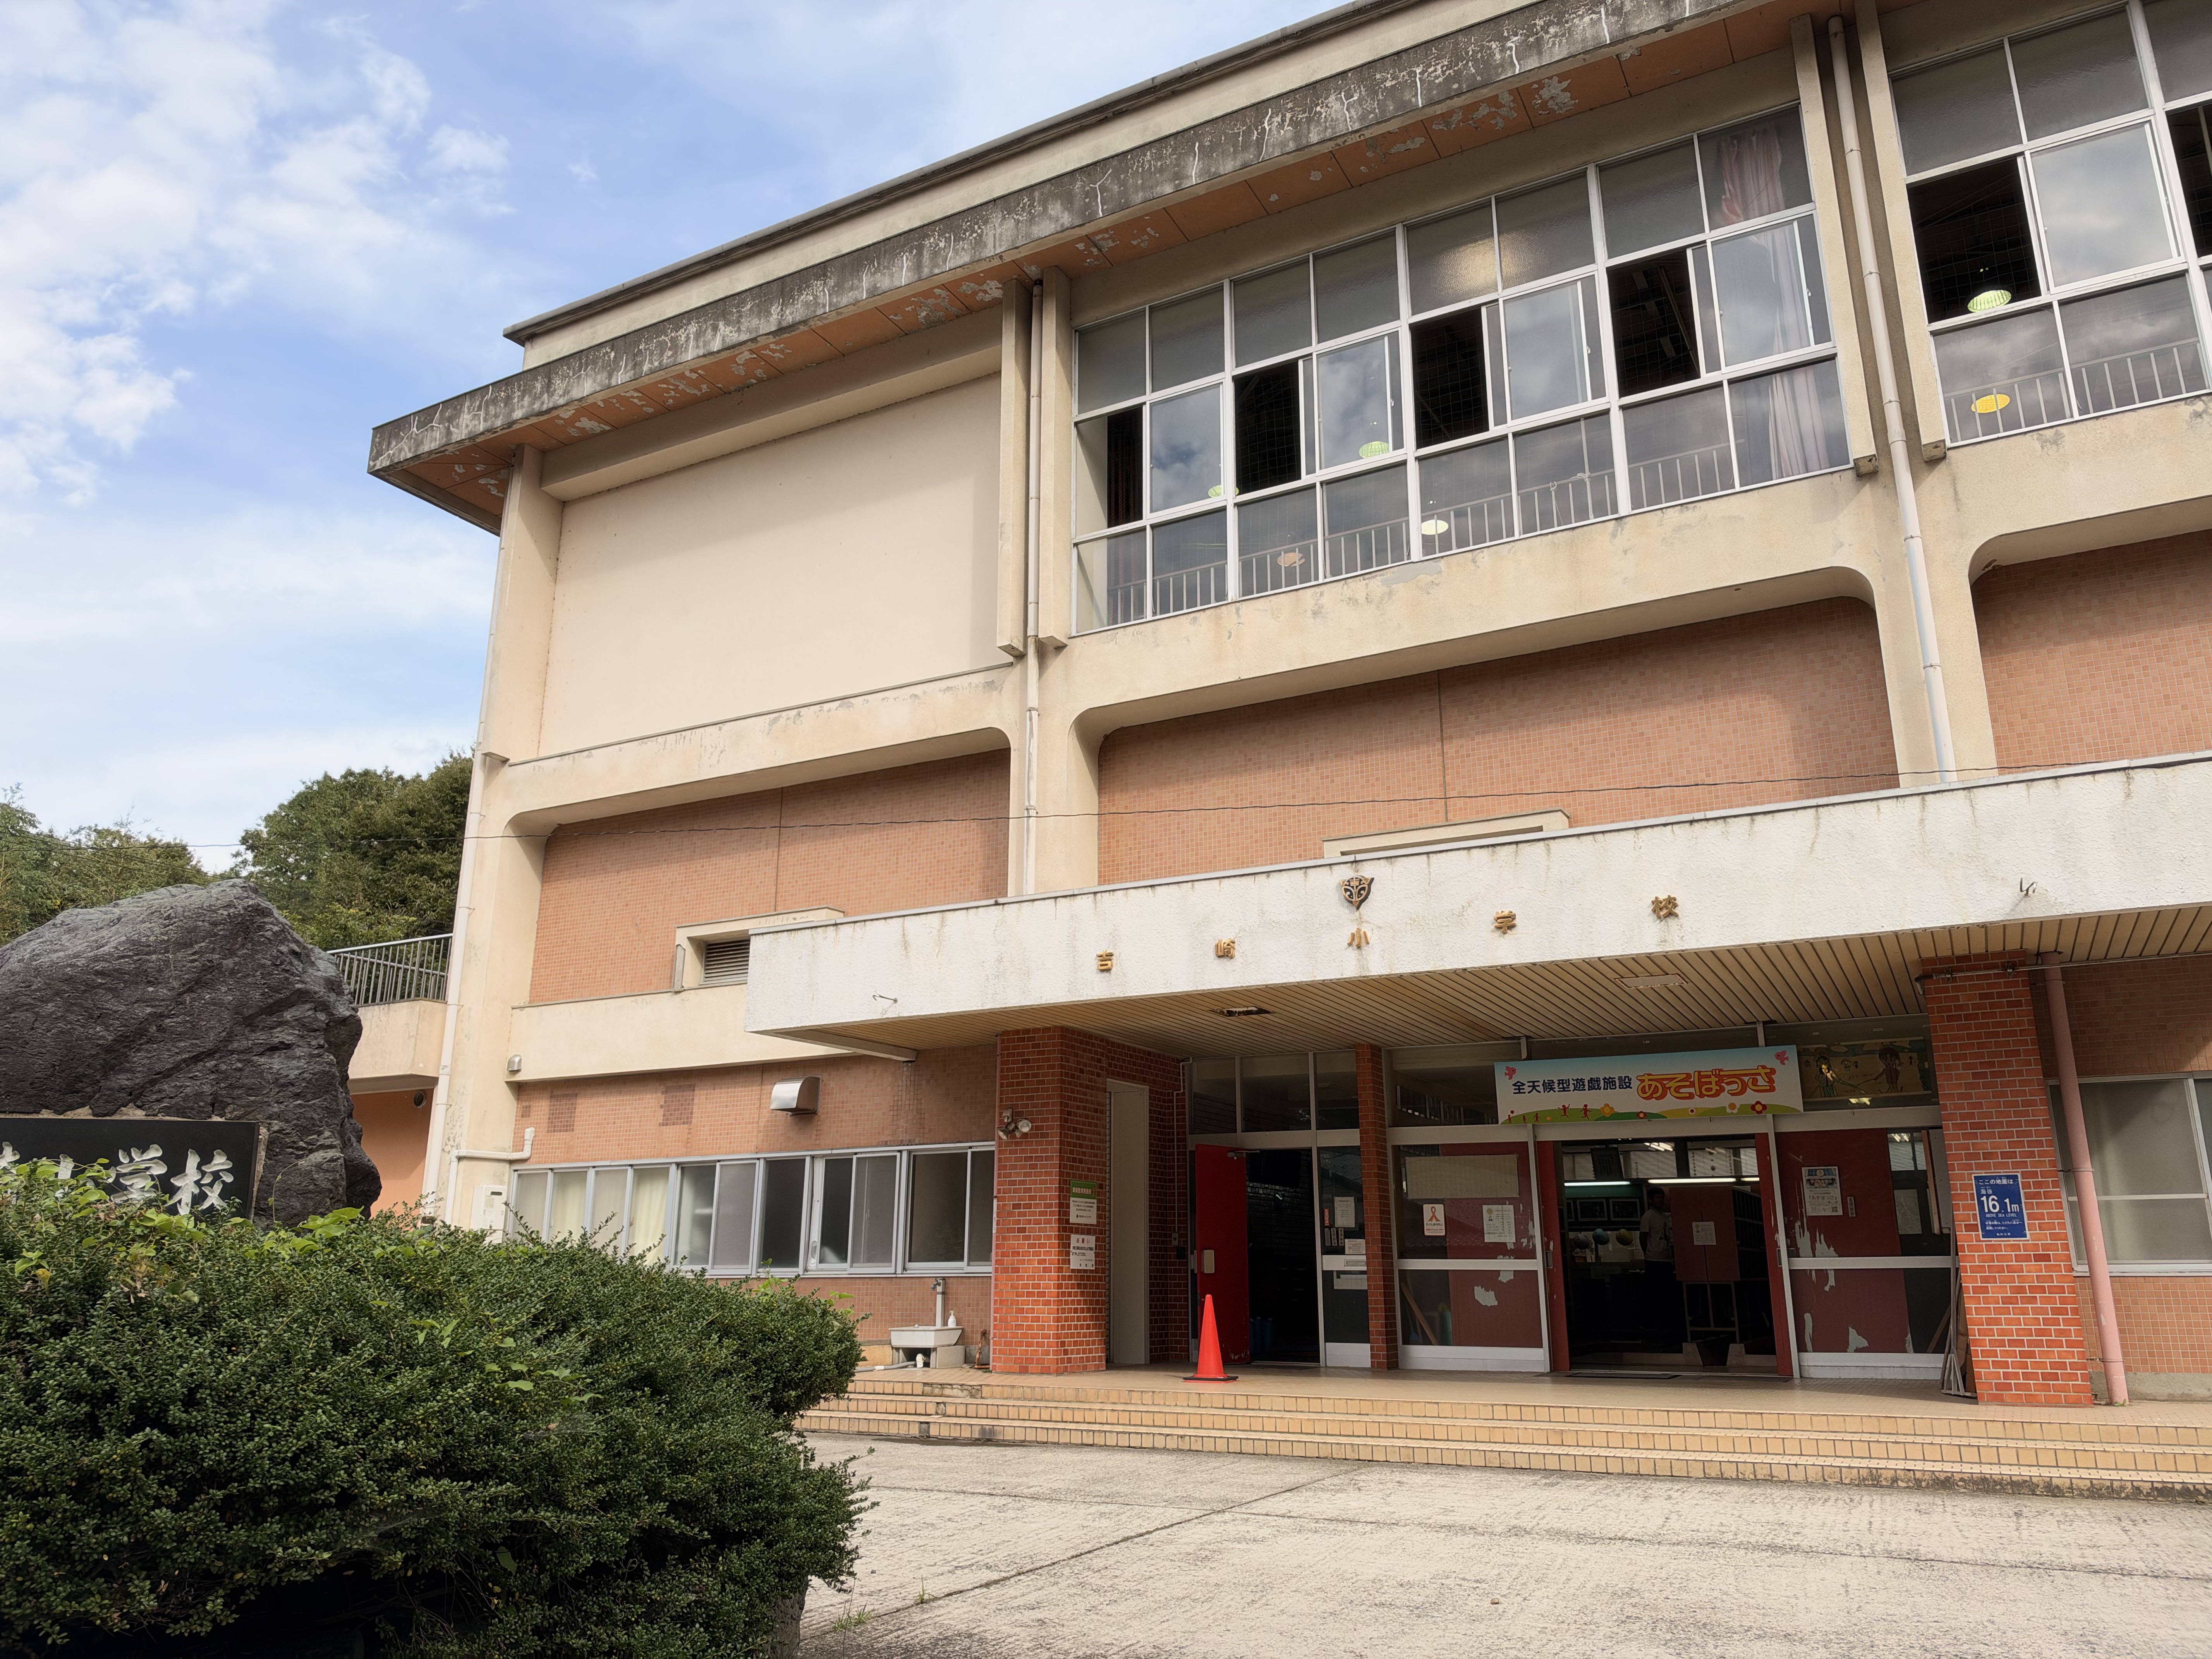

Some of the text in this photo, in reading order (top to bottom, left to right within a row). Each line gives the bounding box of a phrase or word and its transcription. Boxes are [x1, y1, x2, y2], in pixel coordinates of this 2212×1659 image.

[1096, 895, 1679, 971] 吉崎小学校
[1512, 1065, 1776, 1101] 全天候型遊戯施設 あそぼっさ
[1980, 1195, 2020, 1212] 16.1m
